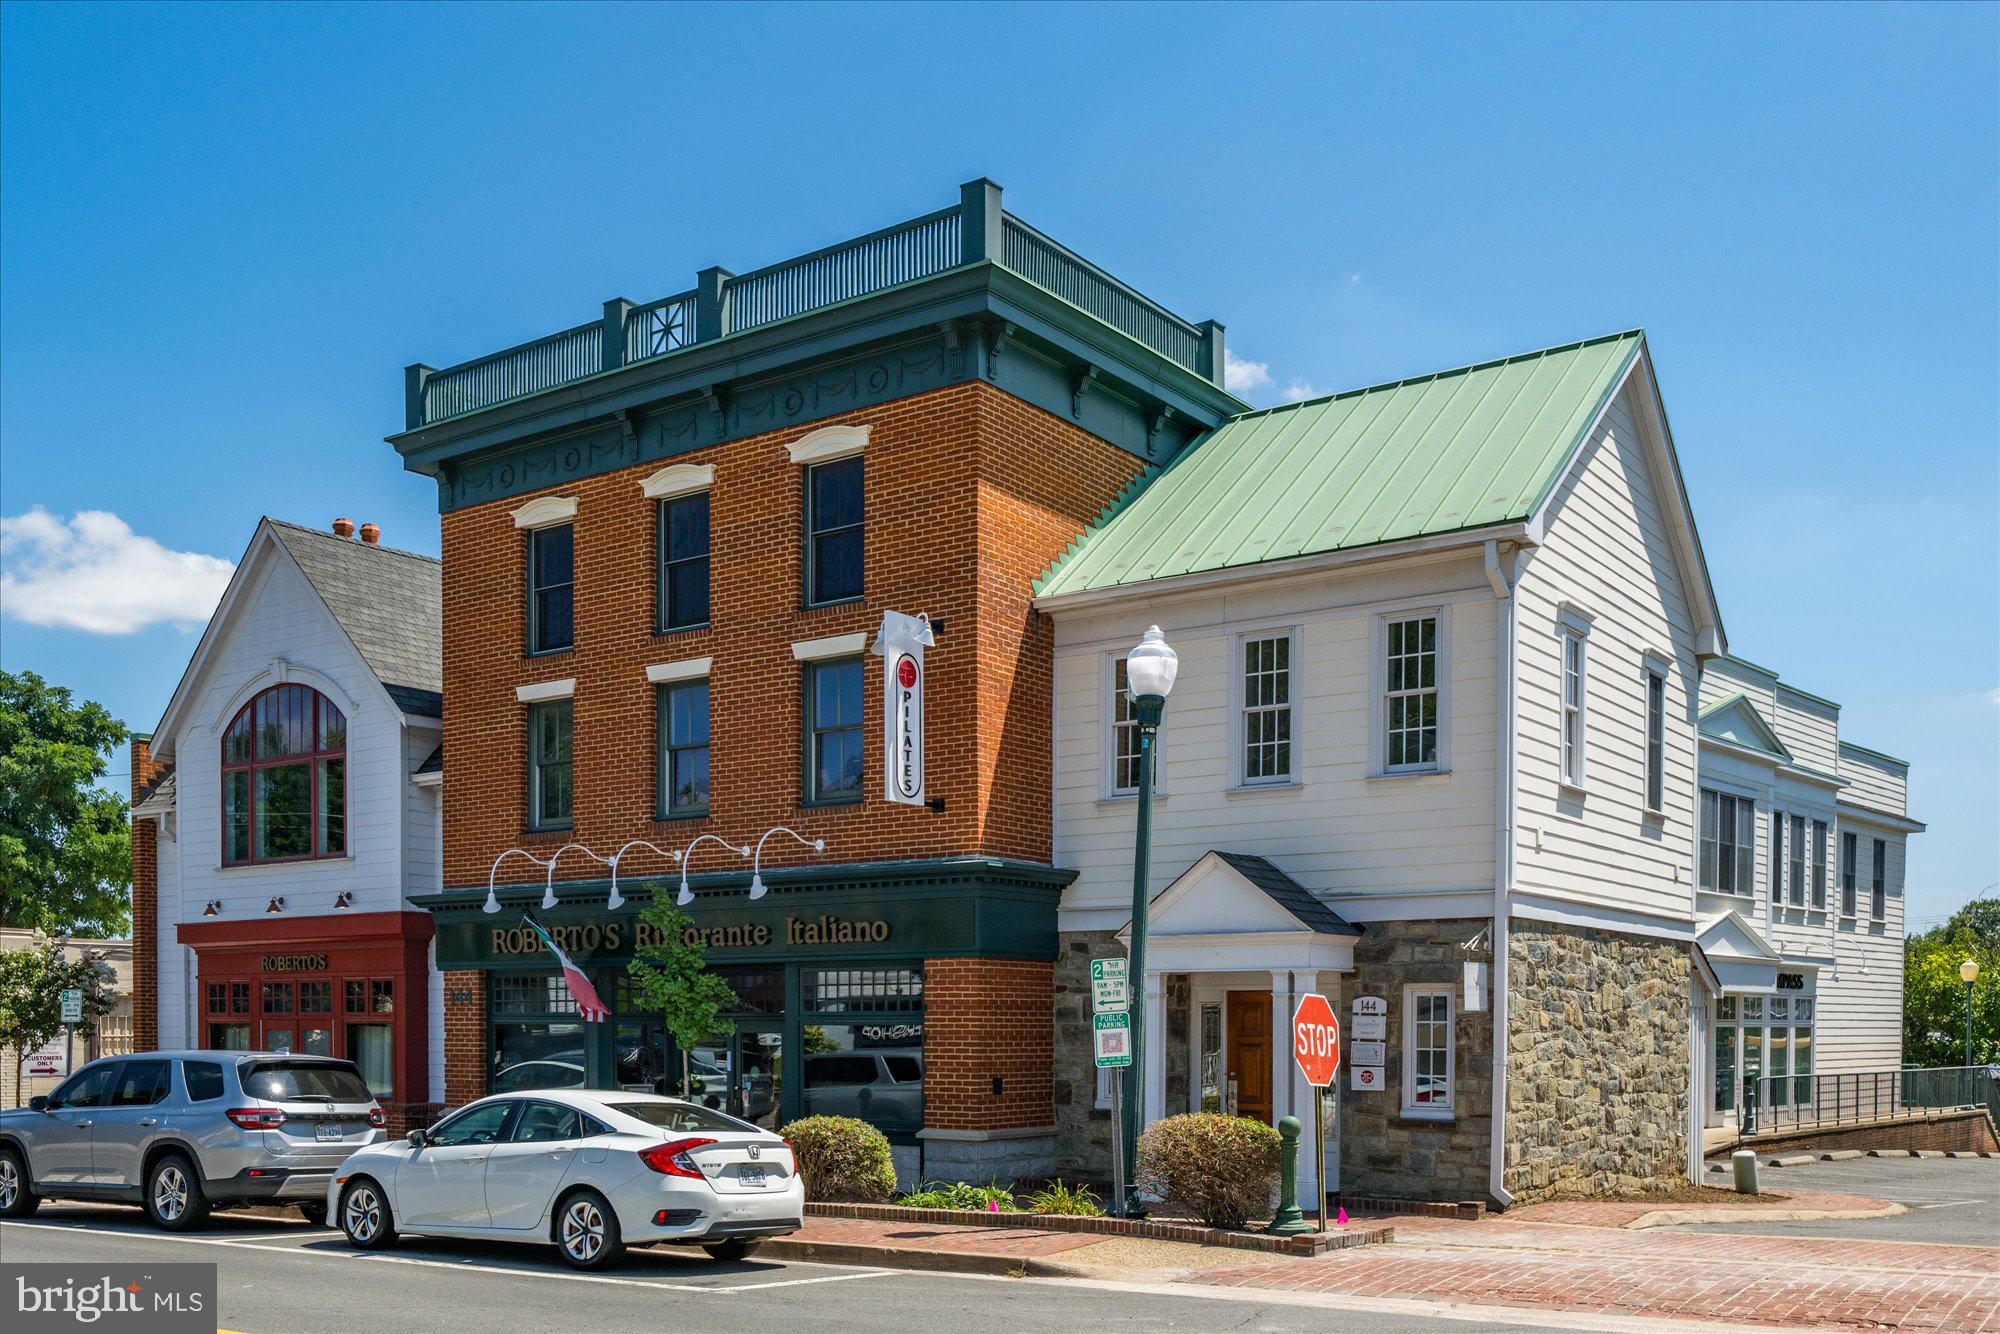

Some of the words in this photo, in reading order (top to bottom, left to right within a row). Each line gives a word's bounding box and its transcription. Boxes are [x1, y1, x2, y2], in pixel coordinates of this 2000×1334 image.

[903, 691, 912, 792] PILATES
[635, 923, 768, 948] Riorante
[786, 914, 888, 945] Italiano
[261, 954, 326, 971] ROBERTO'S
[1093, 964, 1102, 978] 2
[1361, 1000, 1377, 1011] 144
[1098, 1021, 1126, 1029] PARKING
[1100, 1013, 1123, 1022] PUBLIC
[1297, 1022, 1337, 1057] STOP
